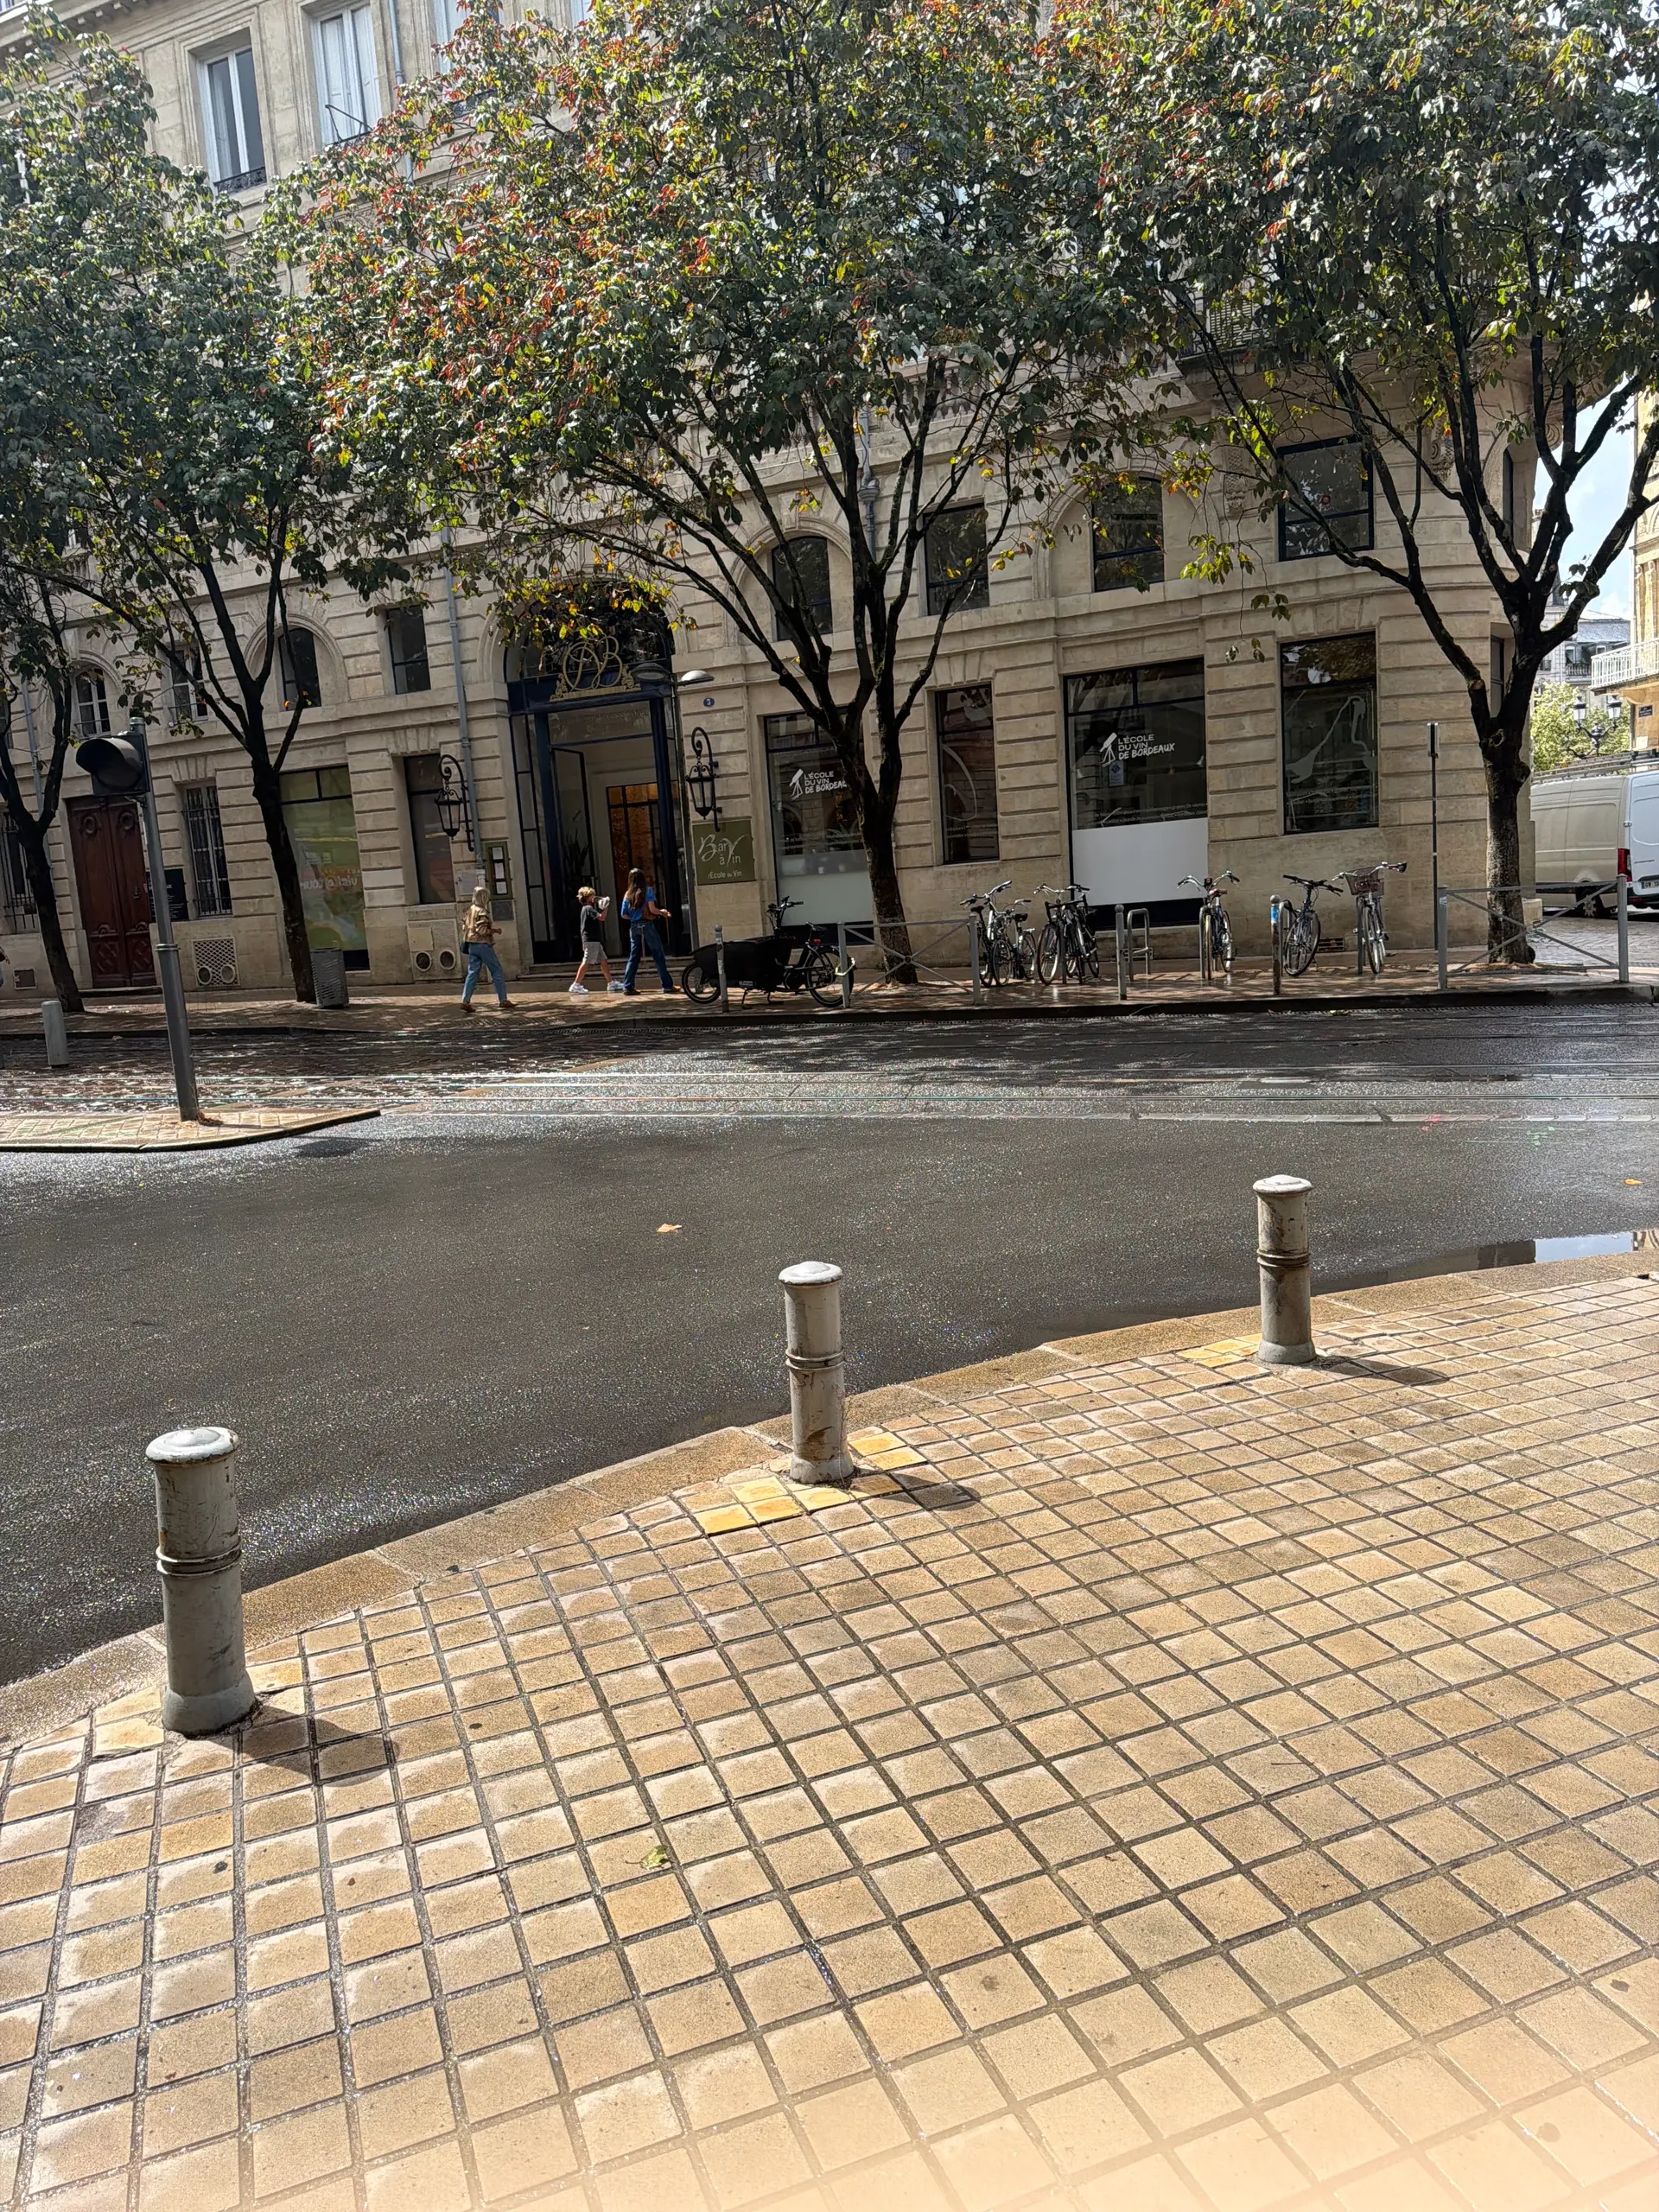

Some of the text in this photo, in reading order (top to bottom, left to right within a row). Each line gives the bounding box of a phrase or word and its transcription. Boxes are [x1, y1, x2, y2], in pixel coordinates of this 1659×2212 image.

[1118, 734, 1154, 745] L'ÉCOLE
[1118, 742, 1175, 760] DE BORDEAUX
[805, 780, 847, 794] DE BORDEAU
[698, 834, 728, 862] Bar
[719, 854, 725, 865] à
